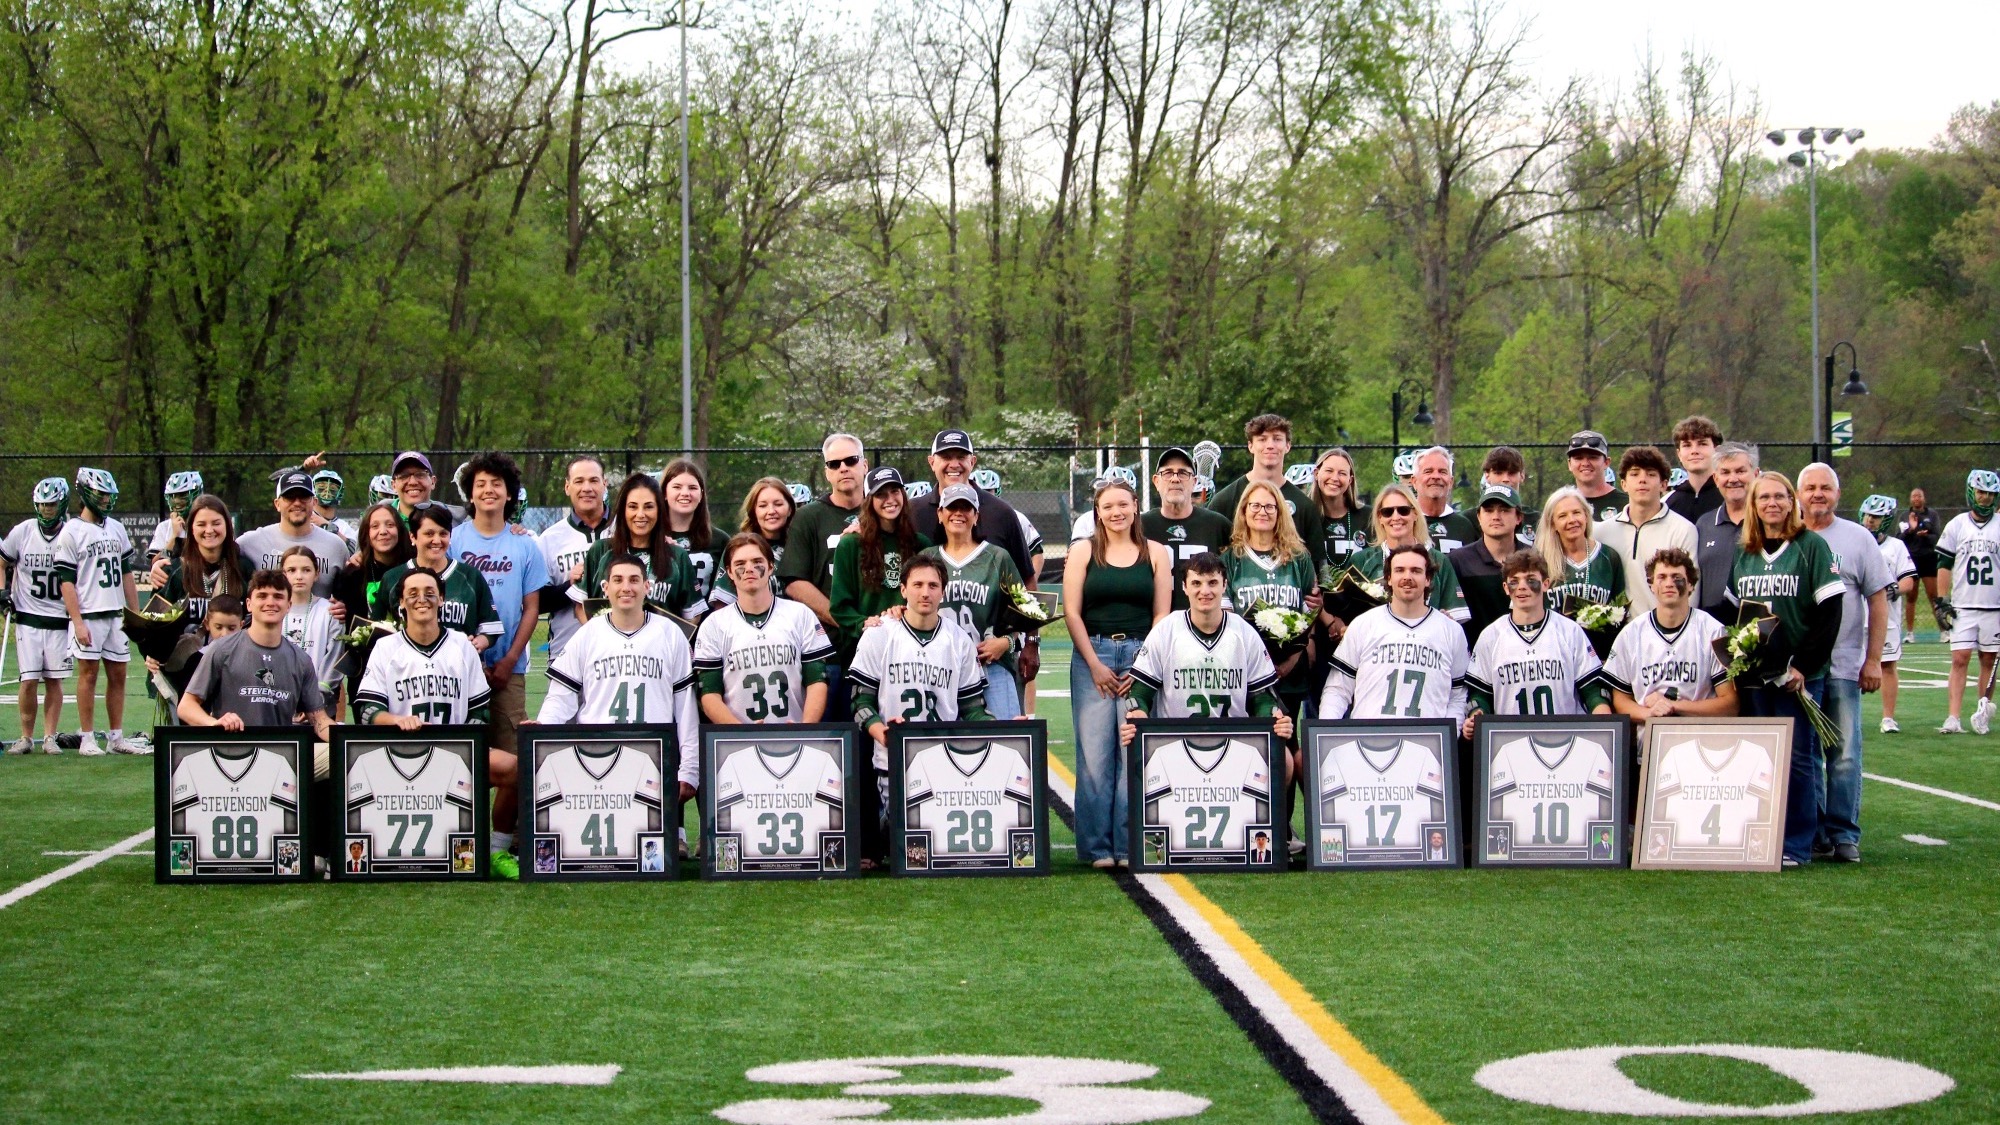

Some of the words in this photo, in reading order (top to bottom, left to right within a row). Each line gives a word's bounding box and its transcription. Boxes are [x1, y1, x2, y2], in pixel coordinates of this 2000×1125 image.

[96, 556, 121, 589] 36
[461, 551, 513, 573] Music
[1966, 555, 1994, 586] 62
[30, 570, 62, 601] 50
[1737, 575, 1800, 599] STEVENSON
[593, 655, 664, 681] STEVENSON
[727, 644, 797, 672] STEVENSON
[1371, 642, 1443, 670] STEVENSON
[888, 663, 953, 690] STEVENSON
[1173, 668, 1243, 690] STEVENSON
[1498, 659, 1566, 686] STEVENSON
[239, 687, 290, 701] STEVENSON
[395, 674, 462, 702] STEVENSON
[742, 670, 790, 722] 33
[1380, 669, 1427, 717] 17
[1514, 685, 1555, 715] 10
[608, 681, 647, 724] 41
[201, 796, 268, 812] STEVENSON
[376, 794, 443, 811] STEVENSON
[565, 793, 632, 810] STEVENSON
[746, 792, 813, 809] STEVENSON
[935, 790, 1002, 806] STEVENSON
[1174, 786, 1240, 803] STEVENSON
[1349, 785, 1414, 802] STEVENSON
[1518, 783, 1584, 799] STEVENSON
[1682, 785, 1746, 801] STEVENSON
[212, 815, 258, 859] 88
[387, 814, 434, 857] 77
[580, 813, 618, 857] 41
[757, 812, 804, 855] 33
[946, 809, 993, 853] 28
[1184, 805, 1231, 849] 27
[1364, 804, 1402, 846] 17
[1532, 802, 1570, 845] 10
[1700, 803, 1721, 846] 4
